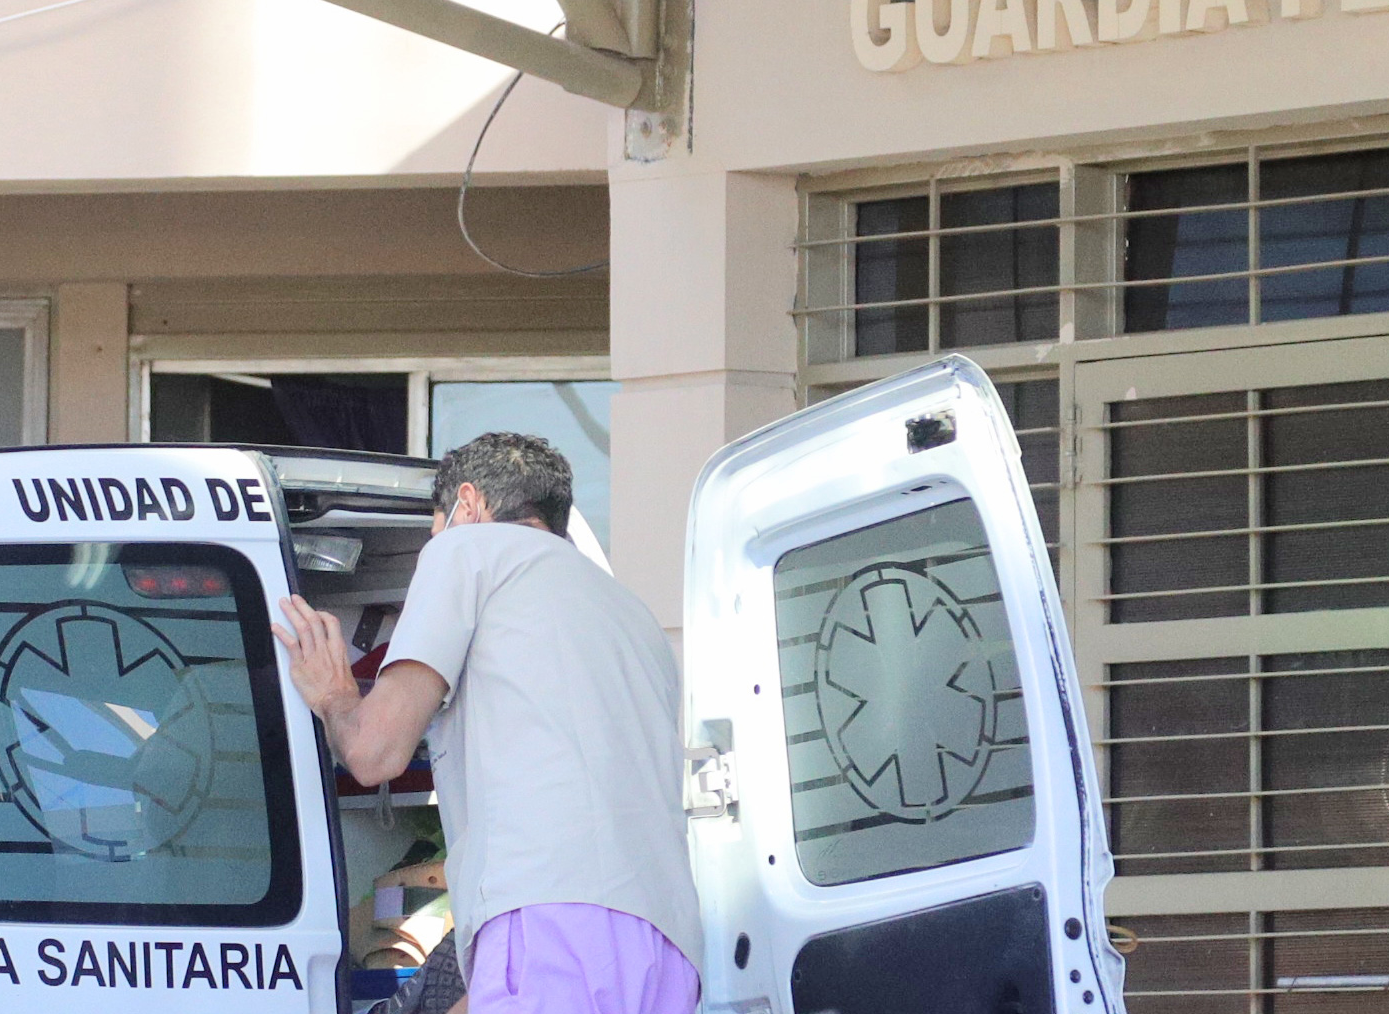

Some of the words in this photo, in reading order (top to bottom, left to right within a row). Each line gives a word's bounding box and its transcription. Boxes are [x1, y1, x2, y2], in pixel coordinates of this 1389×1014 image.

[850, 0, 1249, 71] GUAR
[11, 477, 195, 522] UNIDAD
[205, 478, 272, 521] DE
[37, 938, 303, 990] SANITARIA
